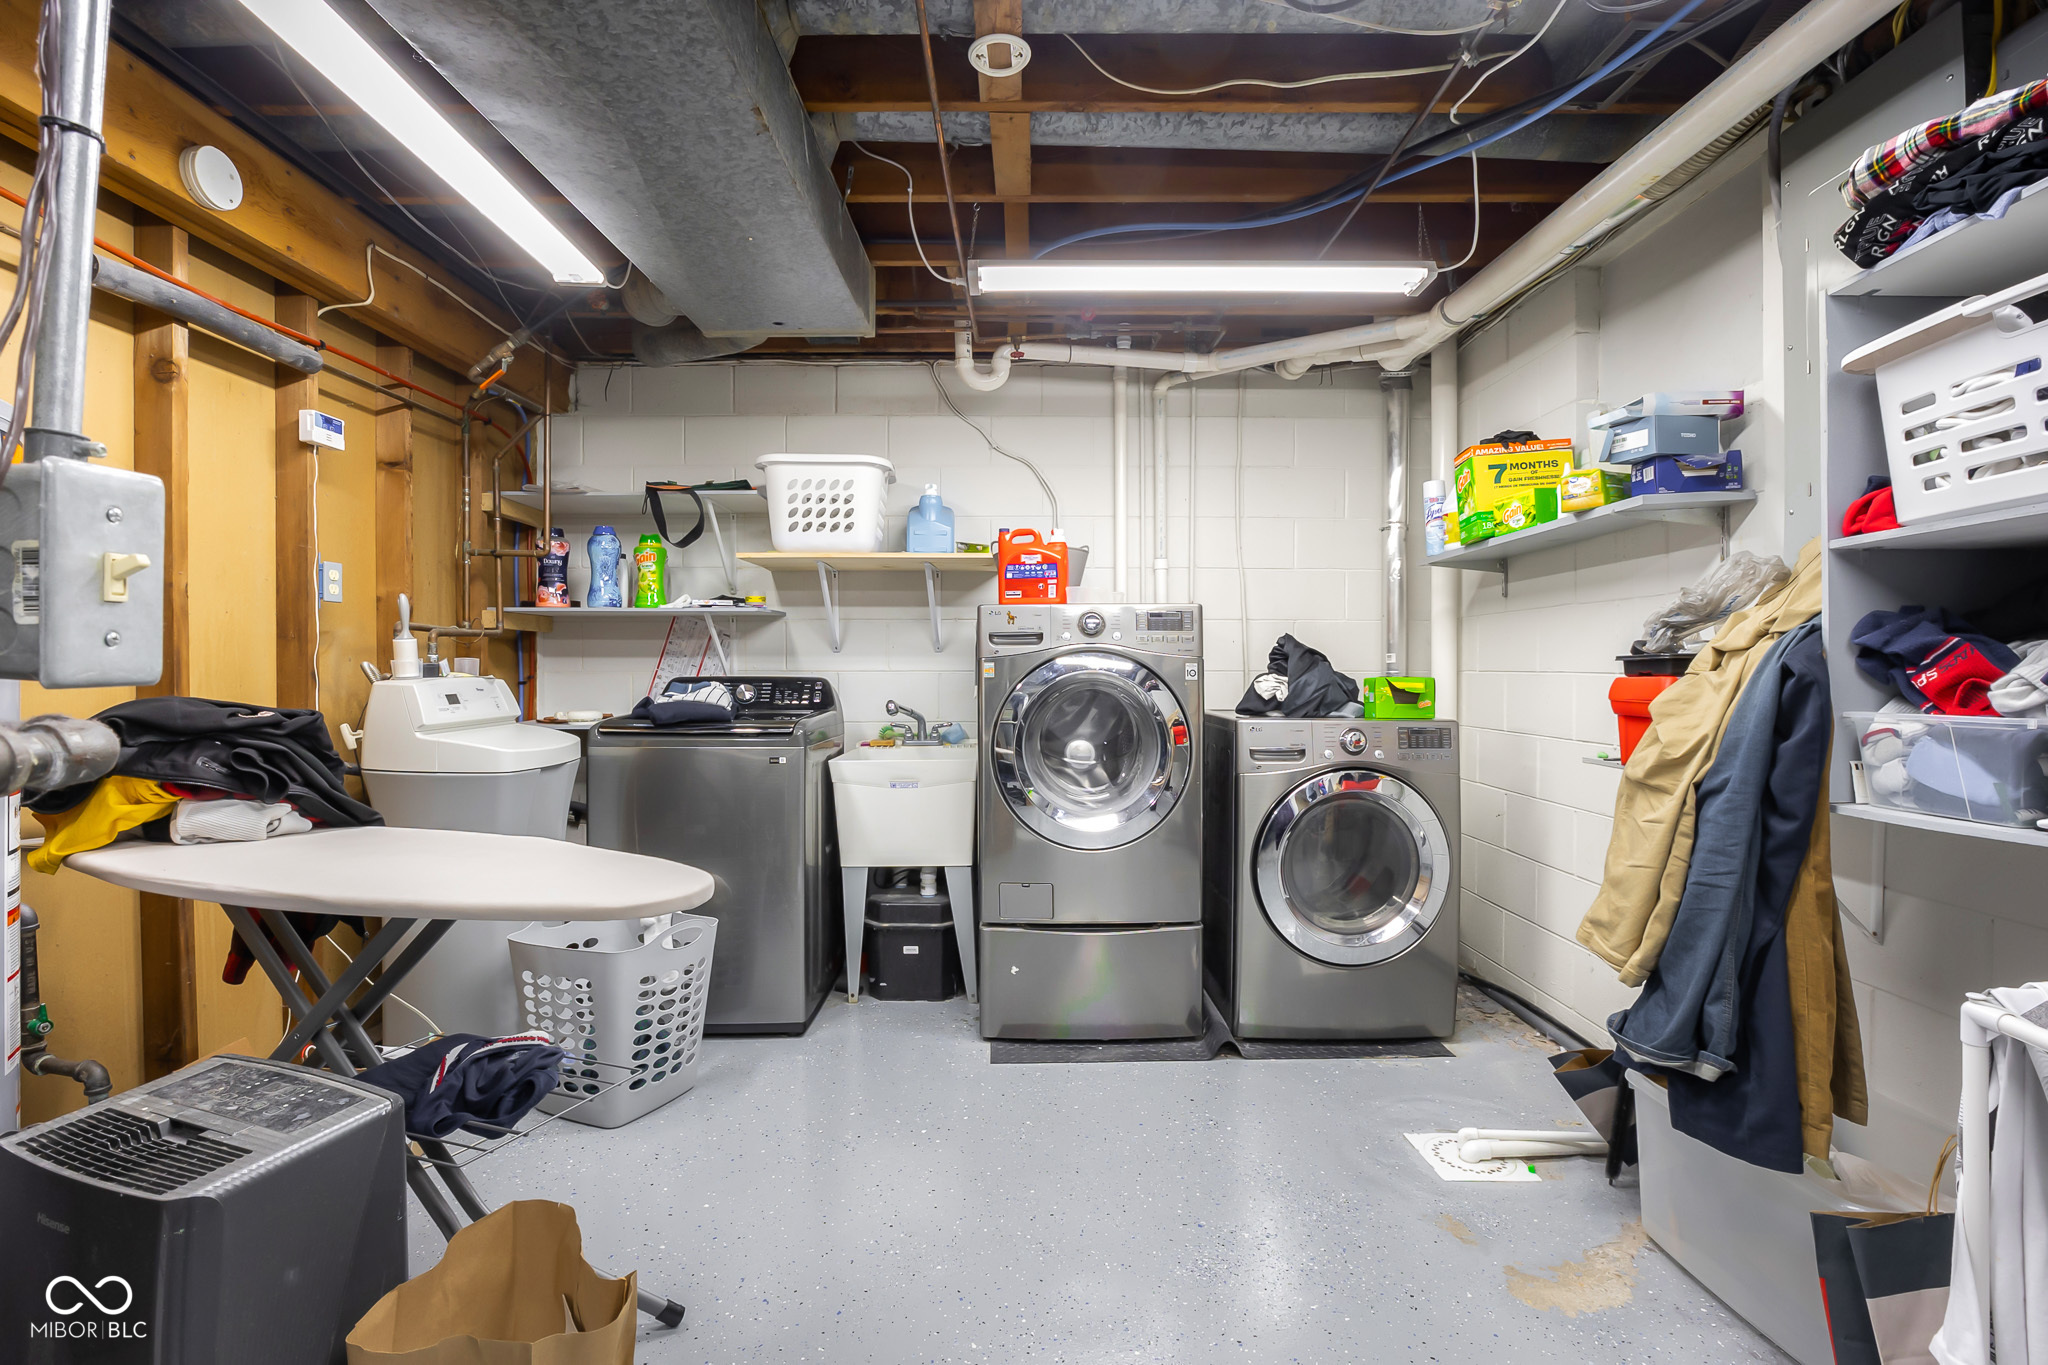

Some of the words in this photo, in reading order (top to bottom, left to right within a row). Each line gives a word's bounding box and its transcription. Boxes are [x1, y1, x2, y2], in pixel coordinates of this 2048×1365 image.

[1871, 214, 1898, 258] RGN
[1475, 446, 1514, 456] AMAZING
[1515, 443, 1545, 452] VALUE!
[1487, 463, 1508, 484] 7
[1509, 459, 1560, 471] MONTHS
[1503, 504, 1522, 524] Gain
[543, 558, 563, 567] Downy
[1910, 667, 1938, 689] SP
[37, 1211, 71, 1235] Hisense
